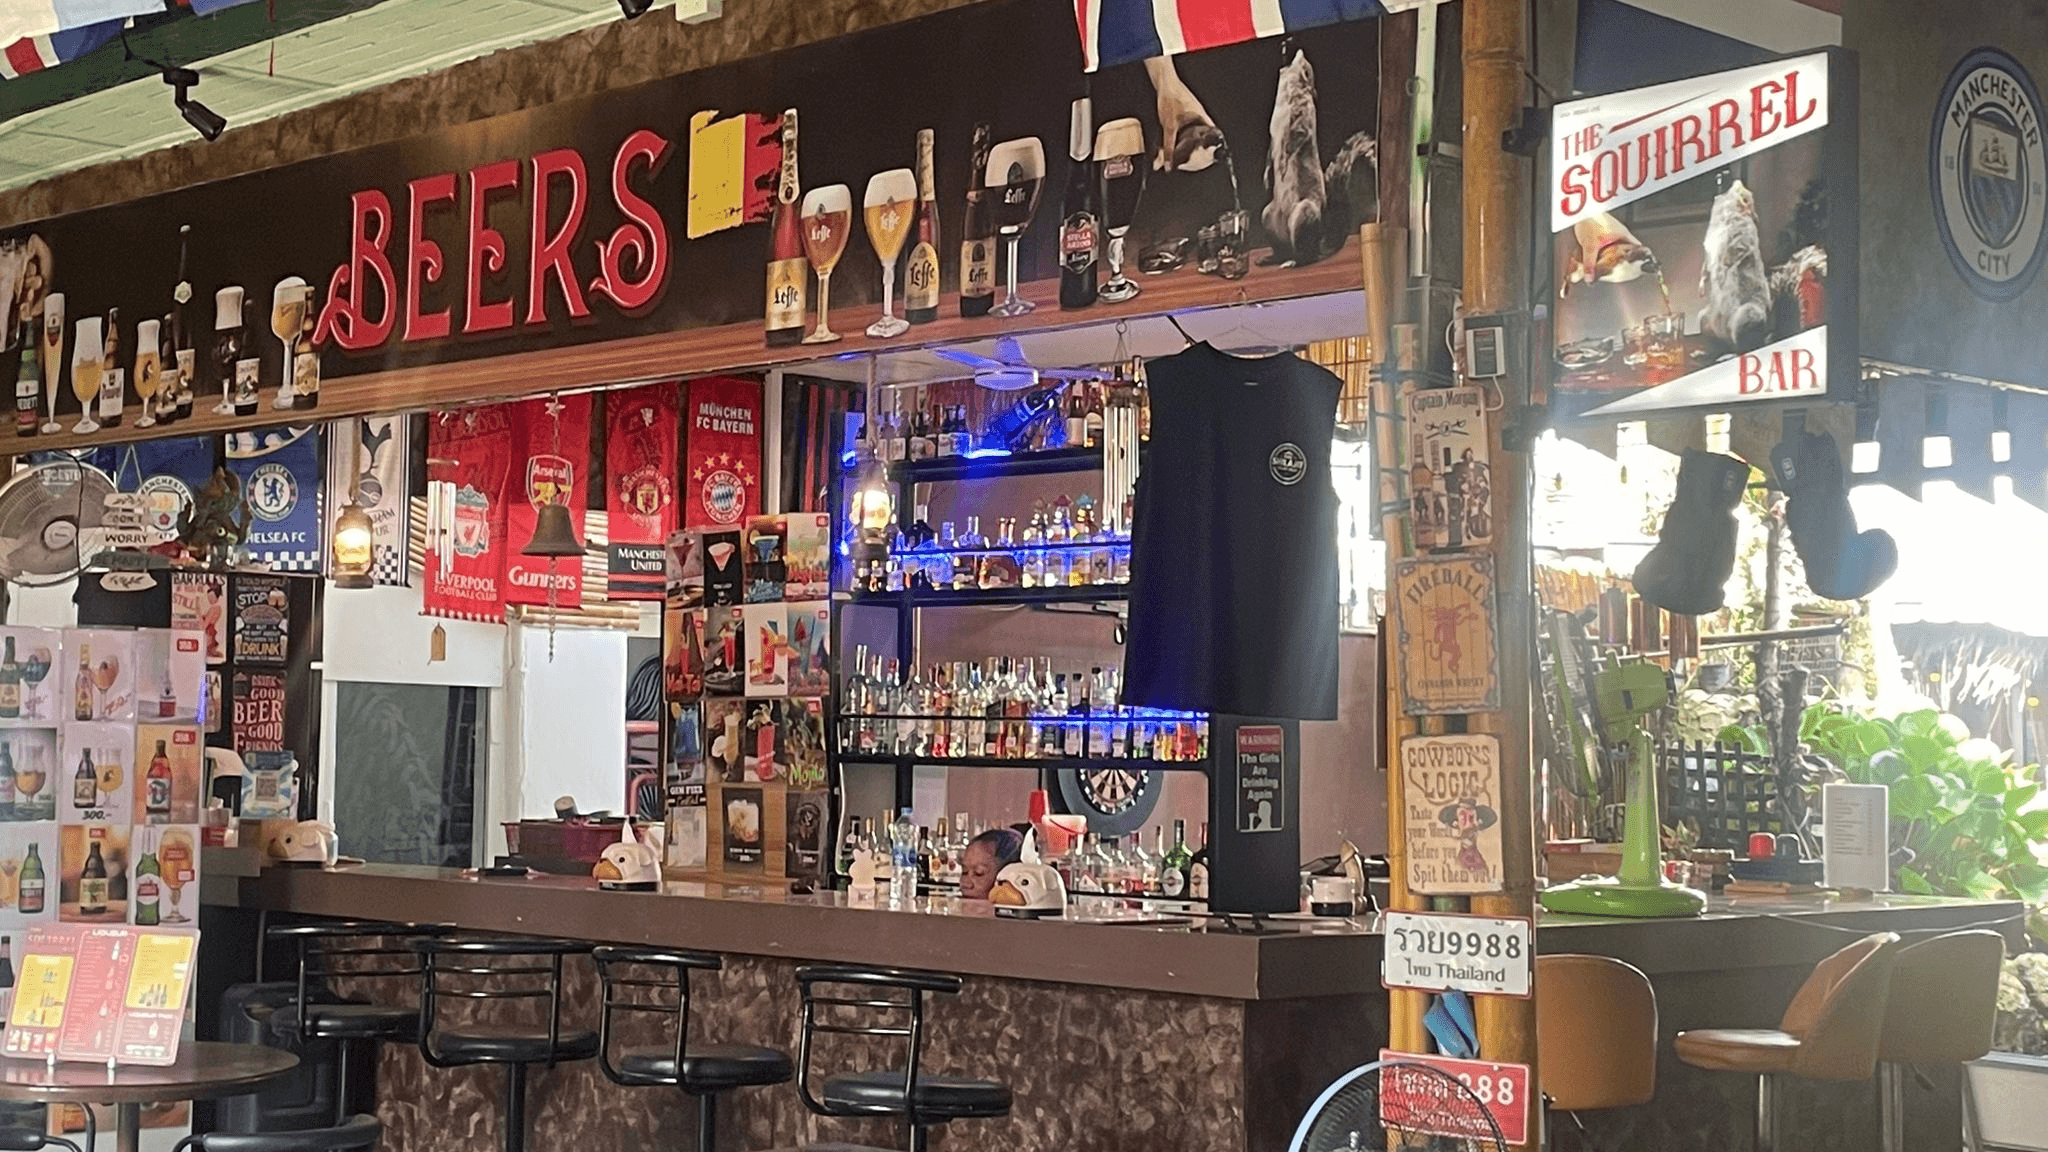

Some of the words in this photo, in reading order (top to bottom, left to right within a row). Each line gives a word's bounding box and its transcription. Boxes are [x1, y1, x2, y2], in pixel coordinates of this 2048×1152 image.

[1951, 72, 2038, 148] MANCHESTER
[1560, 71, 1817, 217] SQUIRREL
[1562, 123, 1603, 160] THE
[1004, 187, 1026, 204] Leffe
[880, 210, 900, 231] Leffe
[312, 129, 668, 350] BEERS
[811, 225, 831, 242] Leffe
[1978, 250, 2012, 276] CITY
[910, 260, 936, 291] Leffe
[968, 268, 988, 284] Leffe
[773, 285, 799, 308] Leffe
[1738, 348, 1820, 395] BAR
[700, 402, 752, 420] MÜNCHEN
[1412, 394, 1447, 414] Captain
[1446, 390, 1478, 408] Morgan
[696, 416, 710, 429] FC
[713, 419, 754, 435] BAYERN
[105, 533, 149, 544] WORRY
[246, 531, 289, 544] HELSEA
[289, 531, 306, 543] FC
[618, 547, 667, 560] MANCHESTE
[630, 559, 663, 572] UNITED
[1406, 567, 1485, 605] FIREBALL
[238, 592, 268, 605] STOP
[242, 642, 279, 656] DRUNK
[250, 688, 285, 700] GOOD
[234, 699, 283, 725] BEER
[248, 722, 283, 741] GOOD
[1240, 753, 1257, 764] The
[1259, 753, 1280, 764] Girls
[1407, 745, 1490, 768] COWBOY'S
[1252, 765, 1268, 775] Are
[1242, 777, 1279, 789] Drinking
[1422, 770, 1479, 798] LOGIC
[1247, 789, 1273, 802] Again
[1407, 827, 1427, 842] your
[1411, 841, 1439, 860] before
[1442, 847, 1458, 864] you
[1413, 863, 1438, 889] Spit
[1441, 863, 1470, 883] them
[1393, 928, 1521, 960] รวย9988
[1405, 957, 1431, 977] ไทย
[1435, 962, 1506, 983] Thailand
